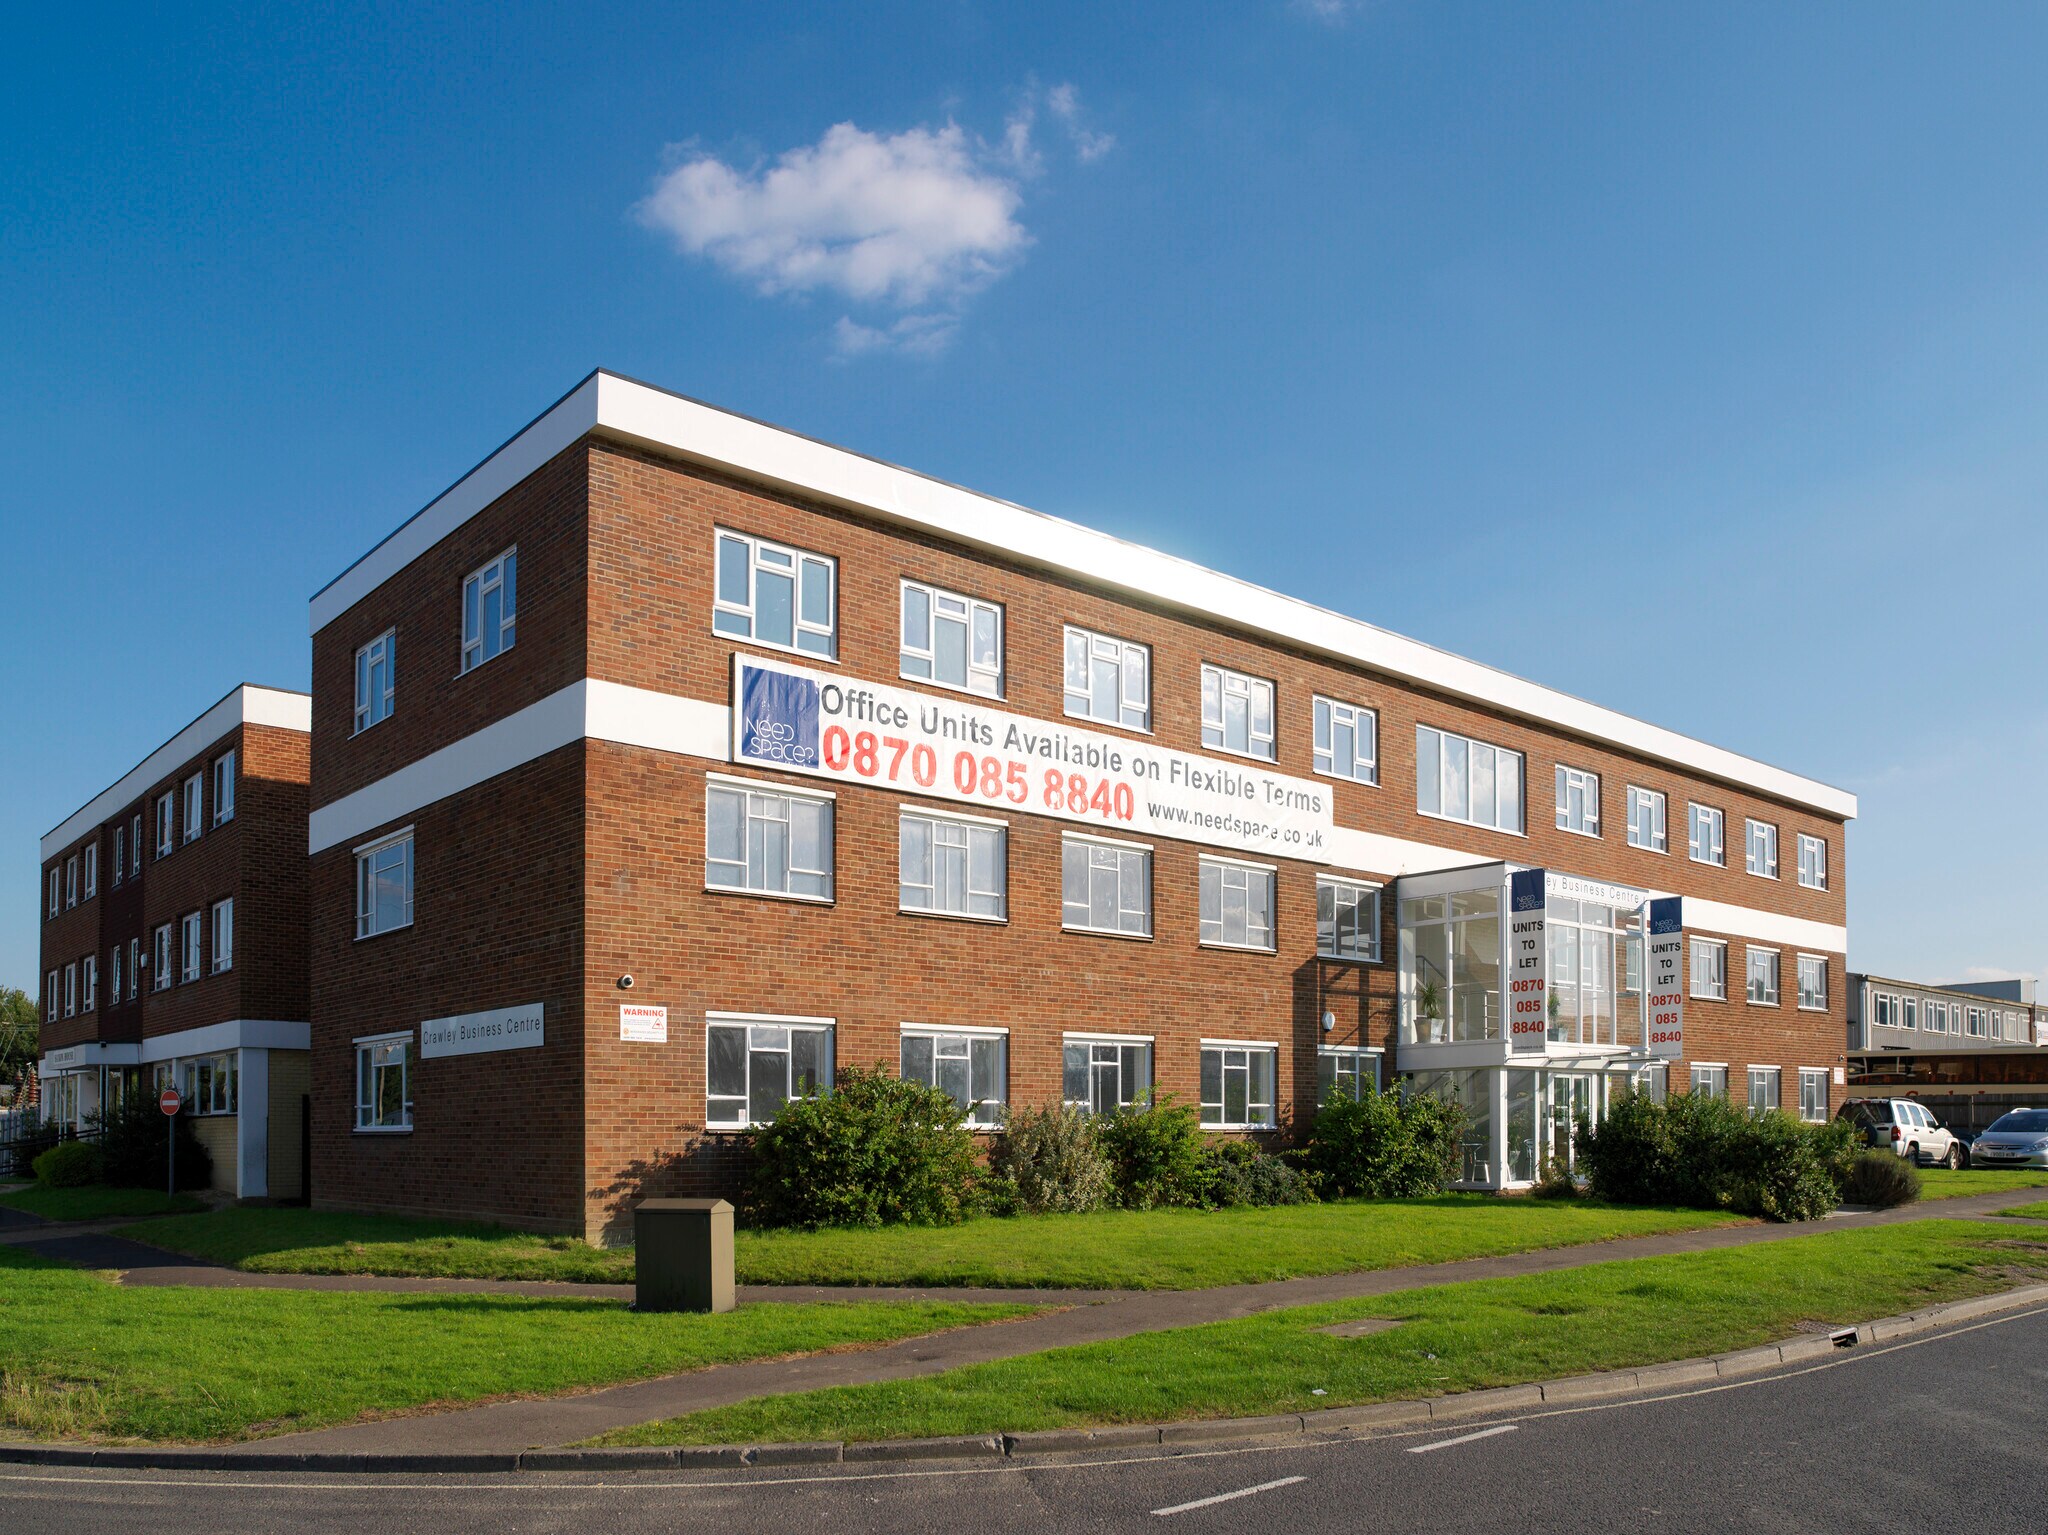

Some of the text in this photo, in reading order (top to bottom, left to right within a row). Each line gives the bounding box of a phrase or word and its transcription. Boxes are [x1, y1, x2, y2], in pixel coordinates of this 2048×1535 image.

[821, 684, 1322, 814] Office Units Available on Flexible Terms
[823, 725, 1134, 822] 0870 085 8840
[1147, 802, 1323, 848] www.needspace.couk
[1562, 877, 1605, 897] Business
[1609, 887, 1639, 904] Centre
[1512, 920, 1544, 933] UNITS
[1521, 939, 1536, 950] TO
[1651, 942, 1681, 954] UNITS
[1519, 957, 1538, 969] LET
[1660, 959, 1672, 968] TO
[1512, 978, 1544, 993] 0870
[1657, 974, 1675, 985] LET
[1516, 1000, 1541, 1013] 085
[1651, 994, 1681, 1007] 0870
[623, 1008, 664, 1017] WARNING
[1655, 1013, 1678, 1024] 085
[423, 1017, 541, 1045] Crawley Business Centre
[1512, 1020, 1545, 1034] 8840
[1651, 1031, 1681, 1043] 8840
